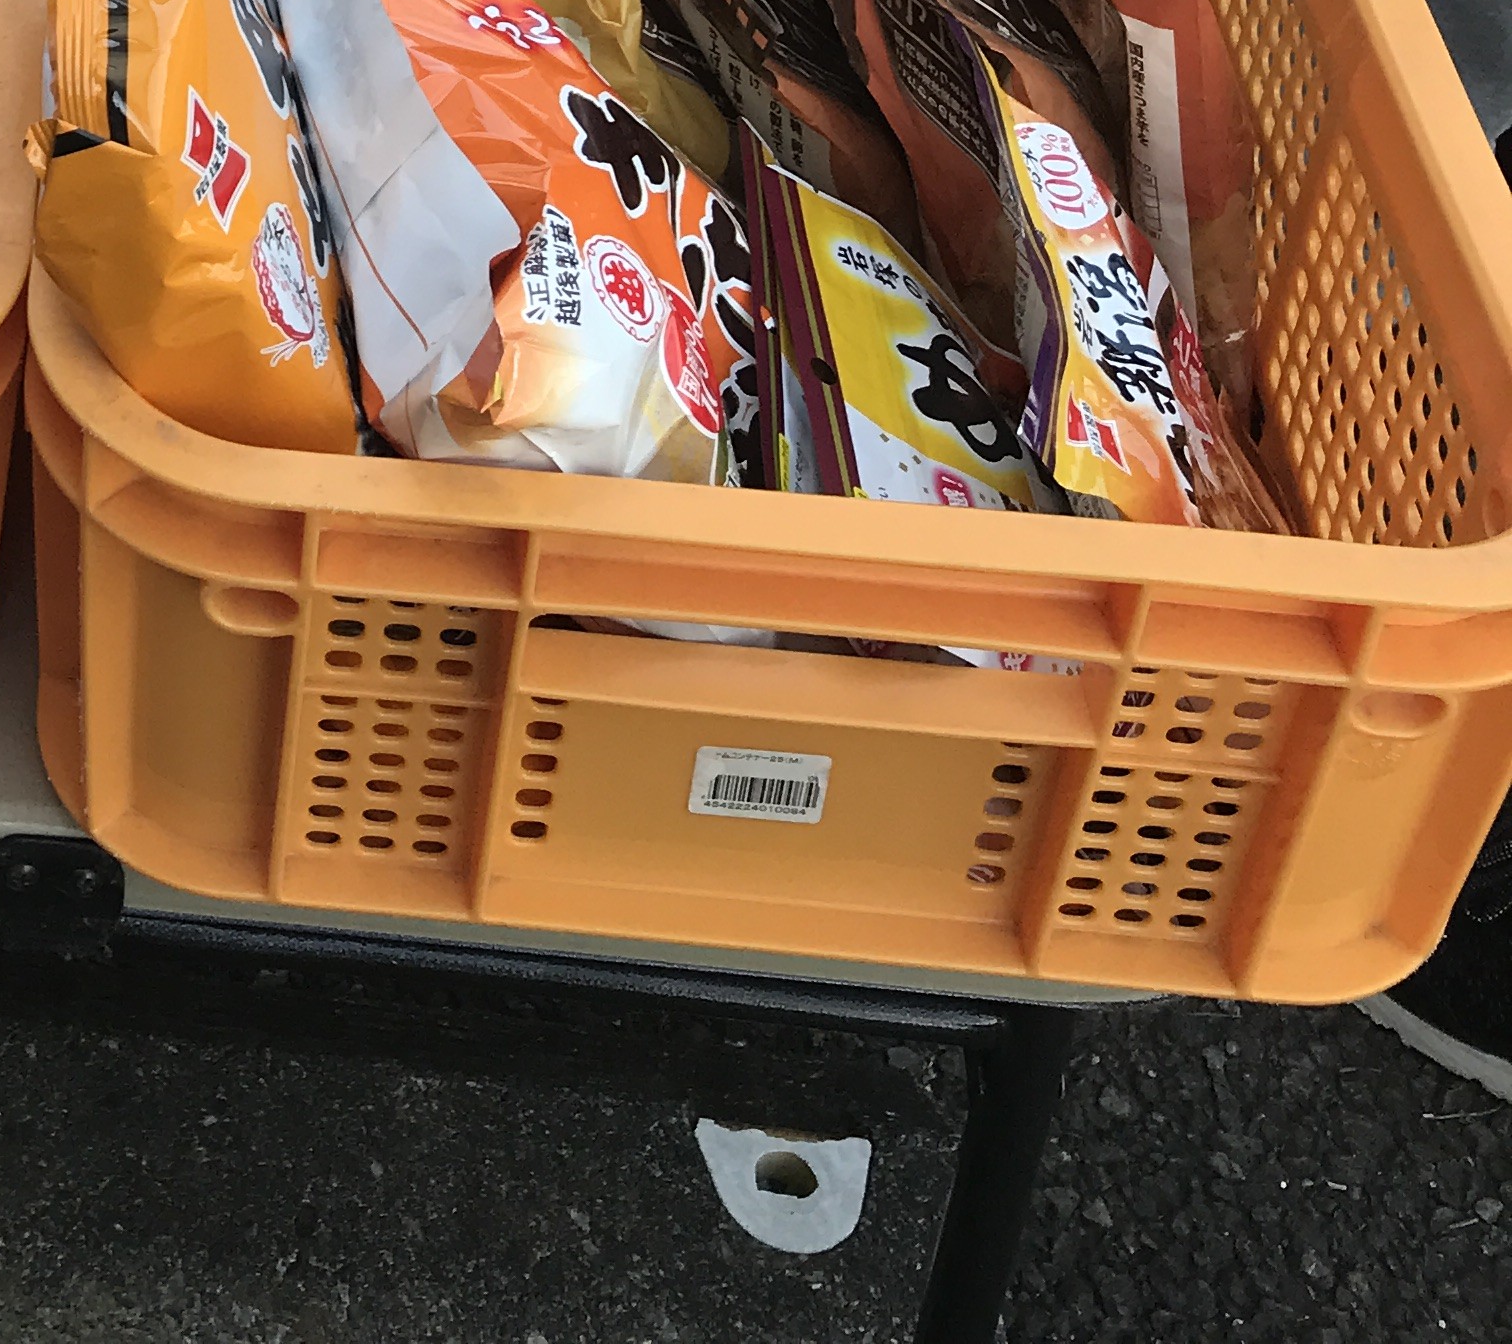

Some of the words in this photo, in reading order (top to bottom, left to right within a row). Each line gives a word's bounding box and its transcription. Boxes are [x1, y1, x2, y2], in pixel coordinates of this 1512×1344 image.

[552, 208, 582, 327] 越後製菓!
[701, 799, 807, 818] 4542224010084
